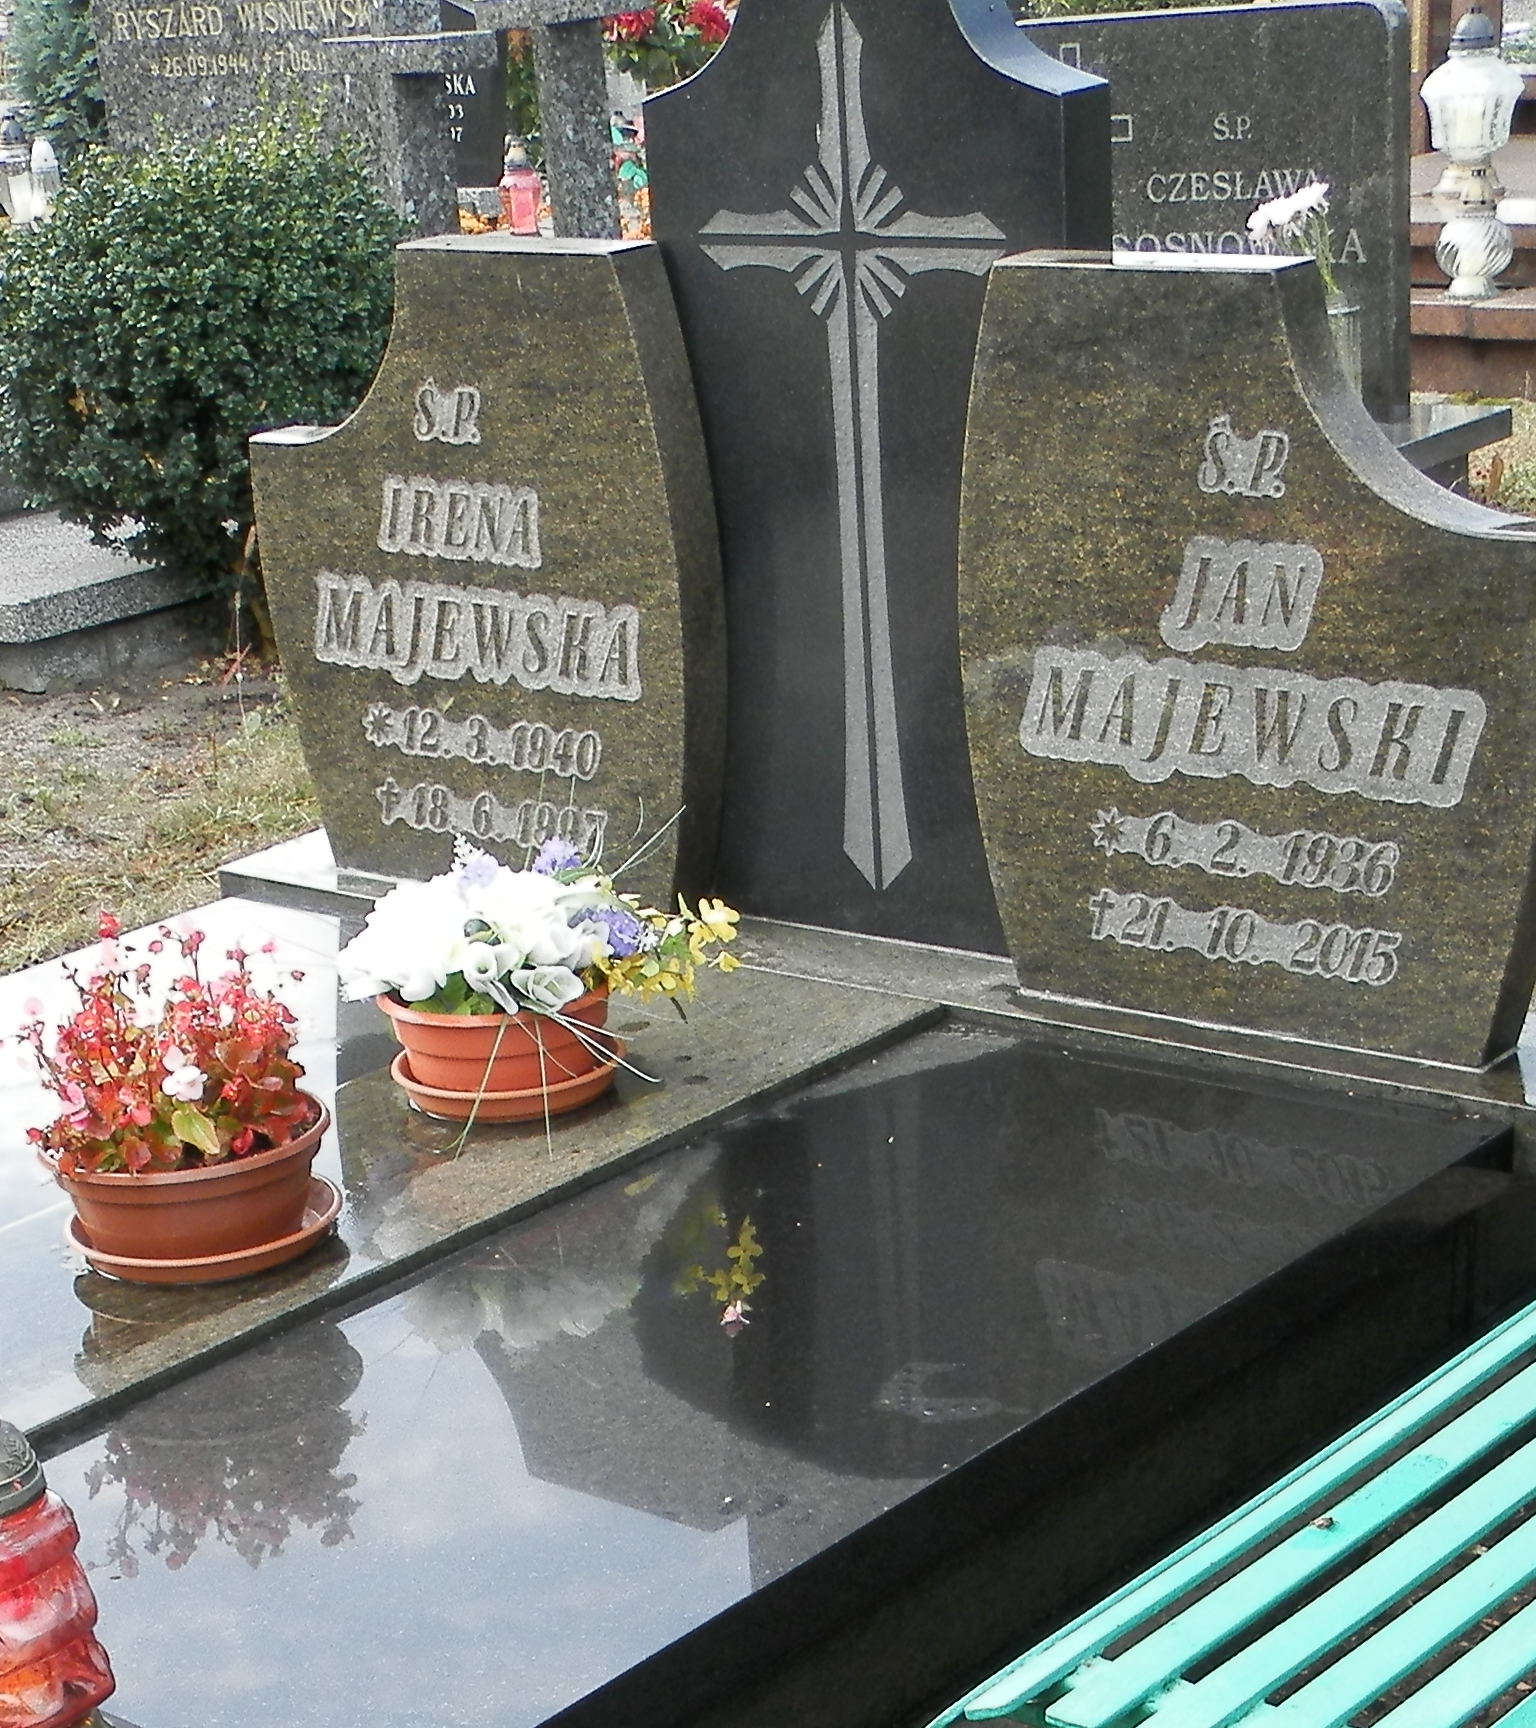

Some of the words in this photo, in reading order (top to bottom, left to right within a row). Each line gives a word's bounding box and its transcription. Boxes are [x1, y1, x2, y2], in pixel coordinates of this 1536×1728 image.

[114, 8, 224, 42] RYSZARD
[236, 0, 372, 32] WIŚNIEWSK
[163, 54, 251, 77] 26.09.1944
[1212, 111, 1253, 141] Ś.P.
[416, 380, 481, 444] Ś.P.
[385, 484, 539, 562] IRENA
[1174, 552, 1311, 636] JAN
[322, 581, 634, 692] MAJEWSKA
[512, 722, 601, 780] 1940
[1035, 664, 1467, 788] MAJEWSKI
[1280, 829, 1402, 899] 1936
[1291, 919, 1404, 988] 2015
